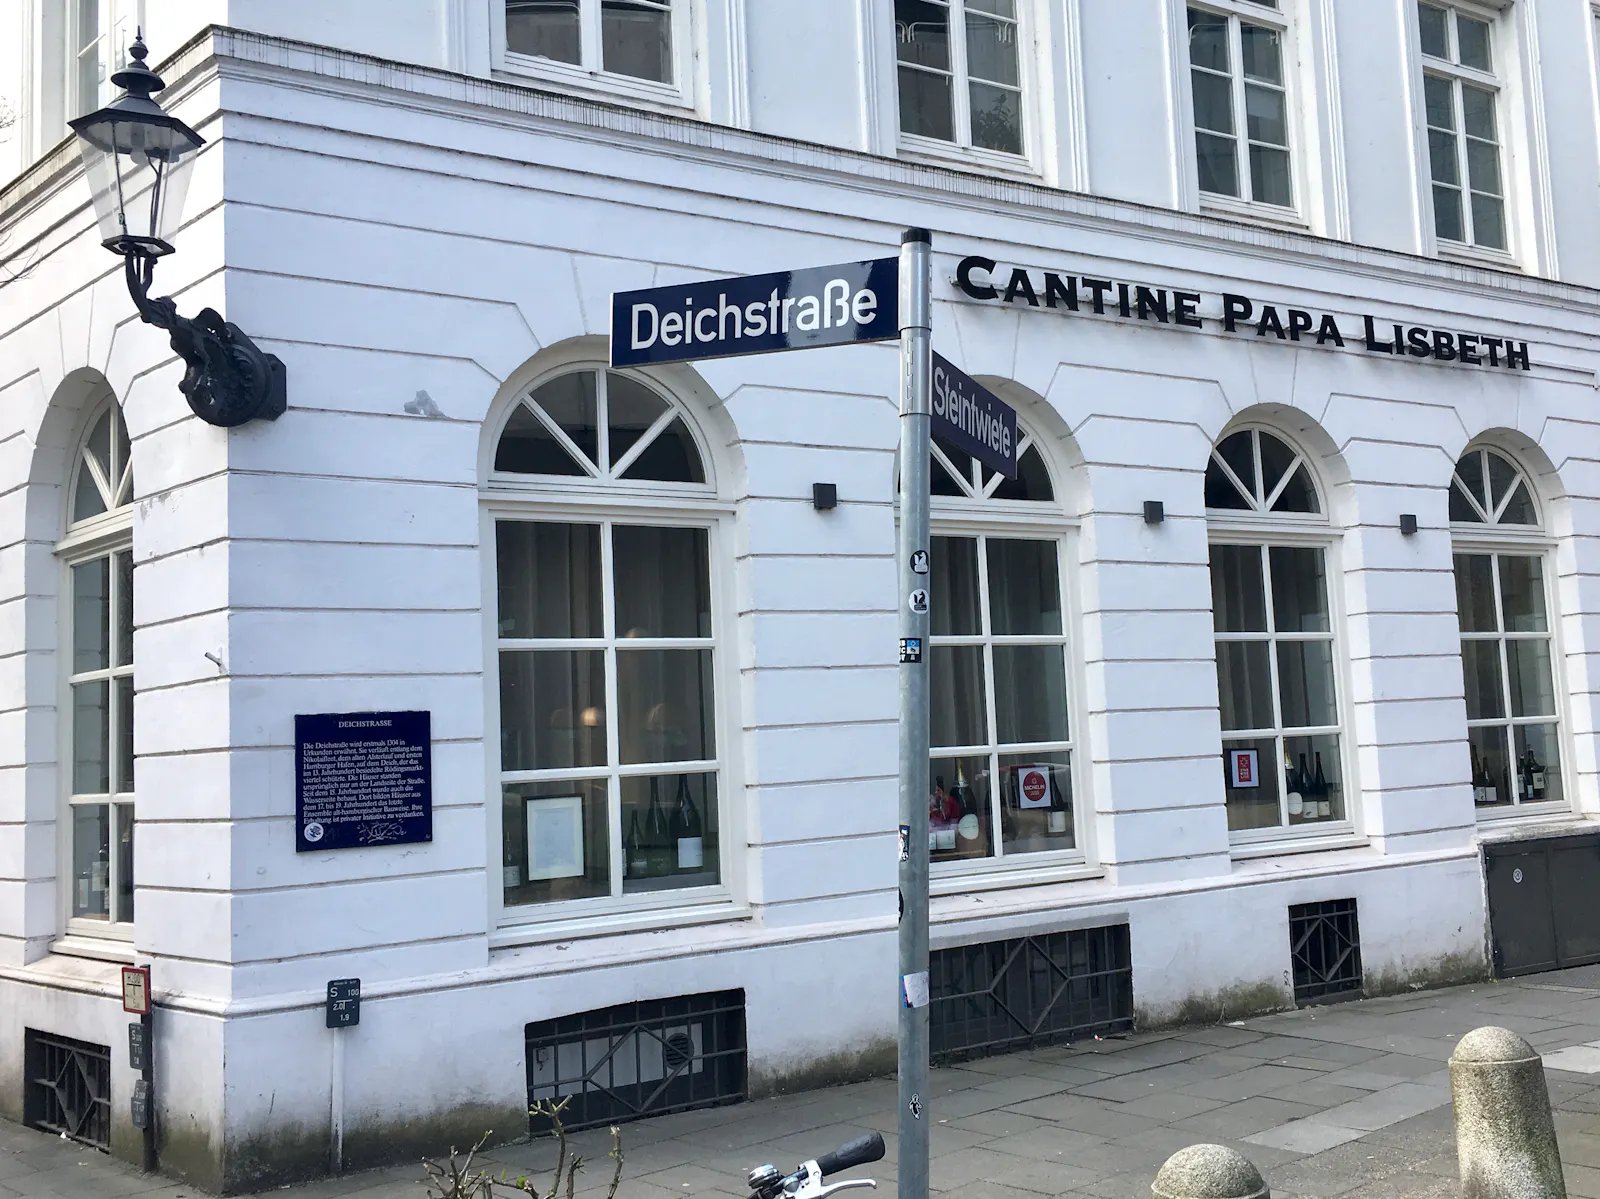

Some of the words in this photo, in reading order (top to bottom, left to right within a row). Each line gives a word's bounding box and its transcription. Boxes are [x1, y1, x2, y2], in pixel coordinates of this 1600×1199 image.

[630, 278, 878, 351] Deichstraße
[956, 255, 1202, 329] CANTINE
[1221, 293, 1345, 347] PAPA
[1363, 314, 1531, 371] LISBETH
[932, 366, 1012, 459] Steintwiete
[338, 720, 392, 728] DEICHSTRASSE
[303, 782, 340, 790] ursprünglich
[344, 800, 378, 808] Jahrhundert
[332, 806, 382, 816] alt-hamburgischer
[340, 815, 362, 823] privater
[394, 810, 424, 818] verdanken.
[330, 986, 338, 998] S
[348, 988, 360, 996] 100
